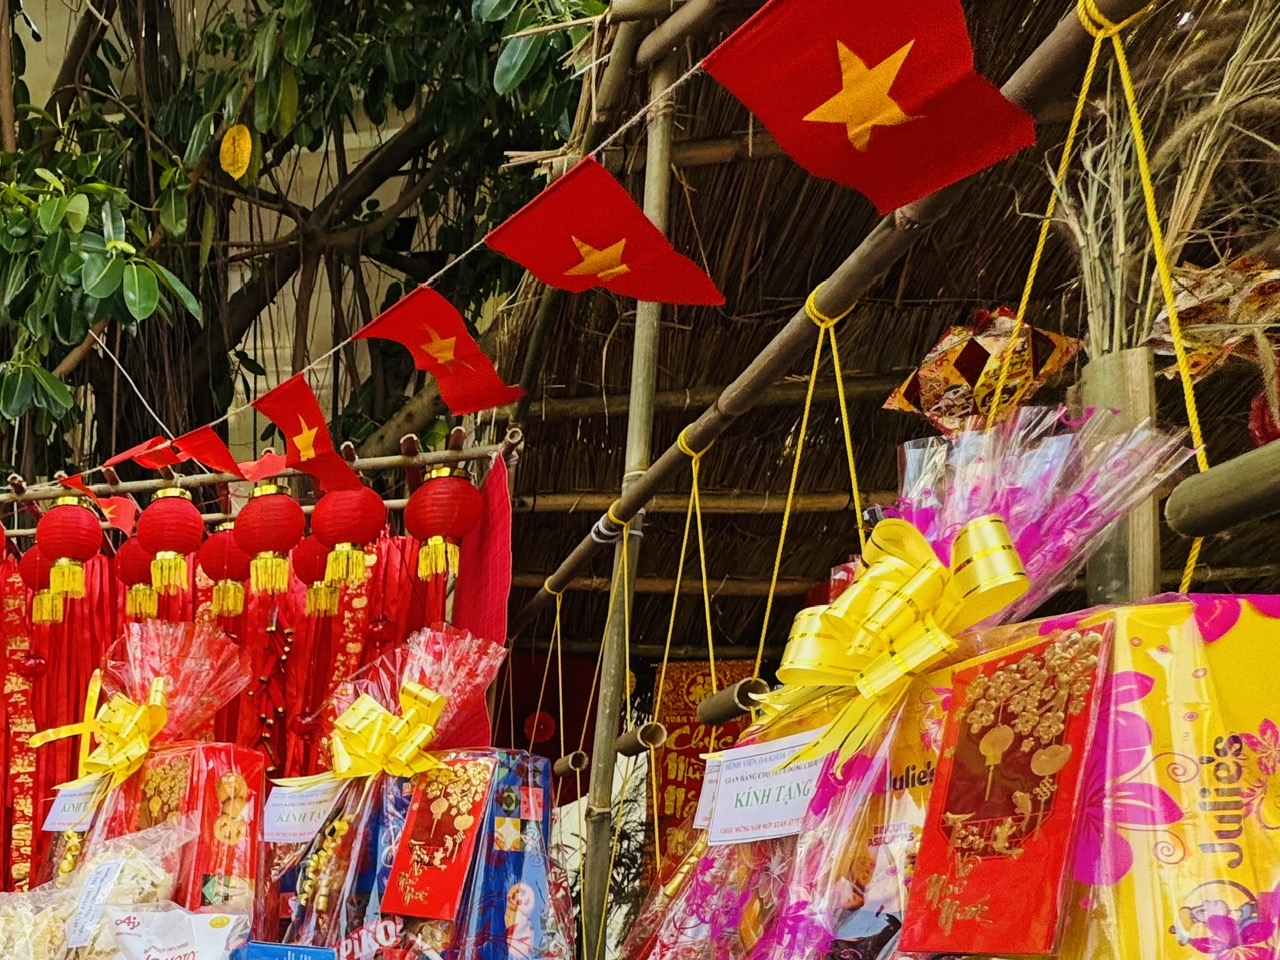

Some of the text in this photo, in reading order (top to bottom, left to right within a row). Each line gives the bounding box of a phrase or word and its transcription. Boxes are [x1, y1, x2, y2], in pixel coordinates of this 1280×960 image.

[734, 779, 813, 808] KÍNH TẶNG
[1199, 734, 1245, 869] Julie's
